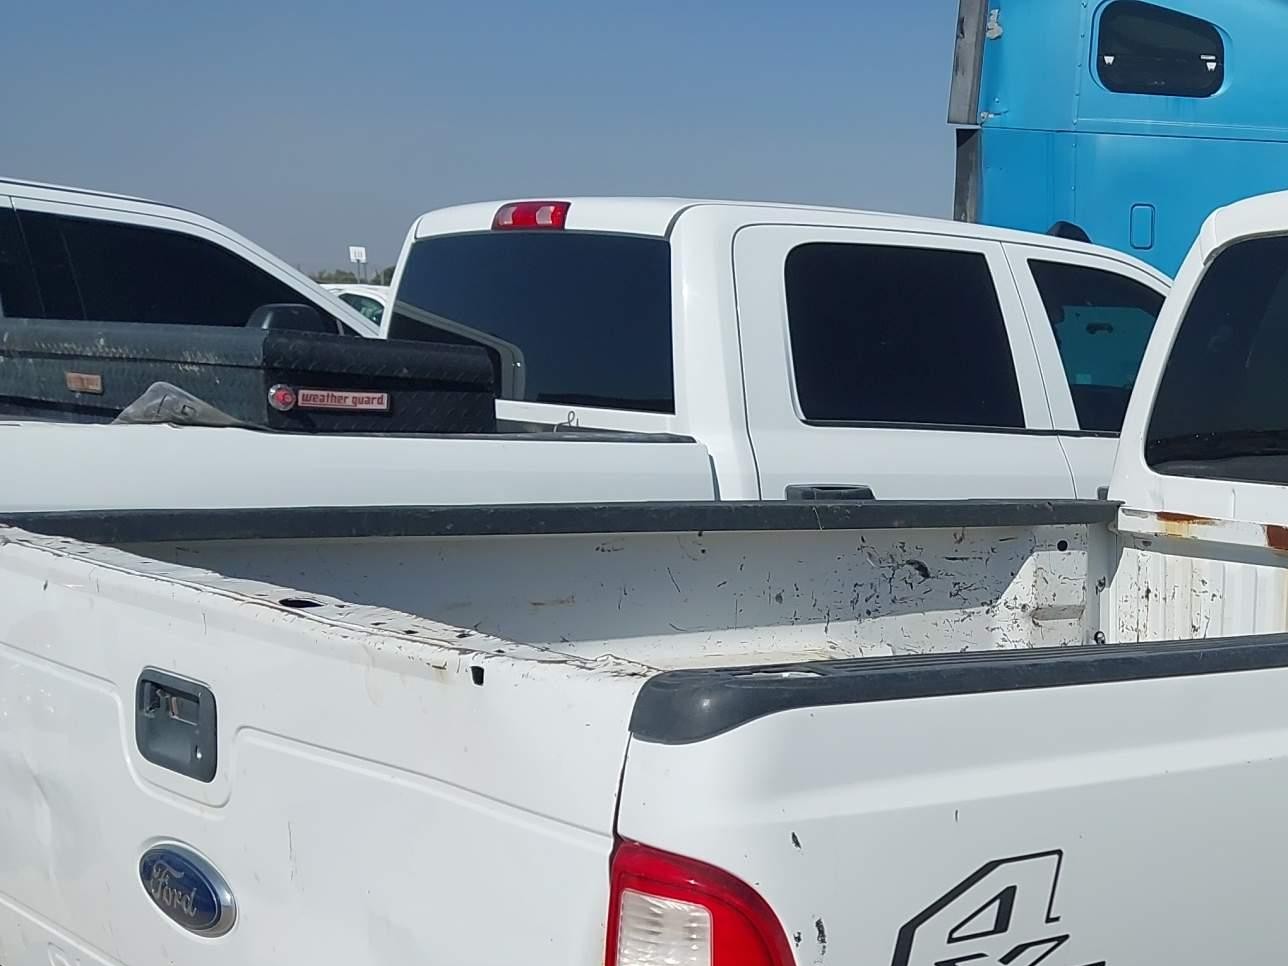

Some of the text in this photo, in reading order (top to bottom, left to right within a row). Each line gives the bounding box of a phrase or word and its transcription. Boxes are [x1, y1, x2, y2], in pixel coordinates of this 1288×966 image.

[301, 392, 385, 407] weather guard
[151, 859, 198, 918] Ford
